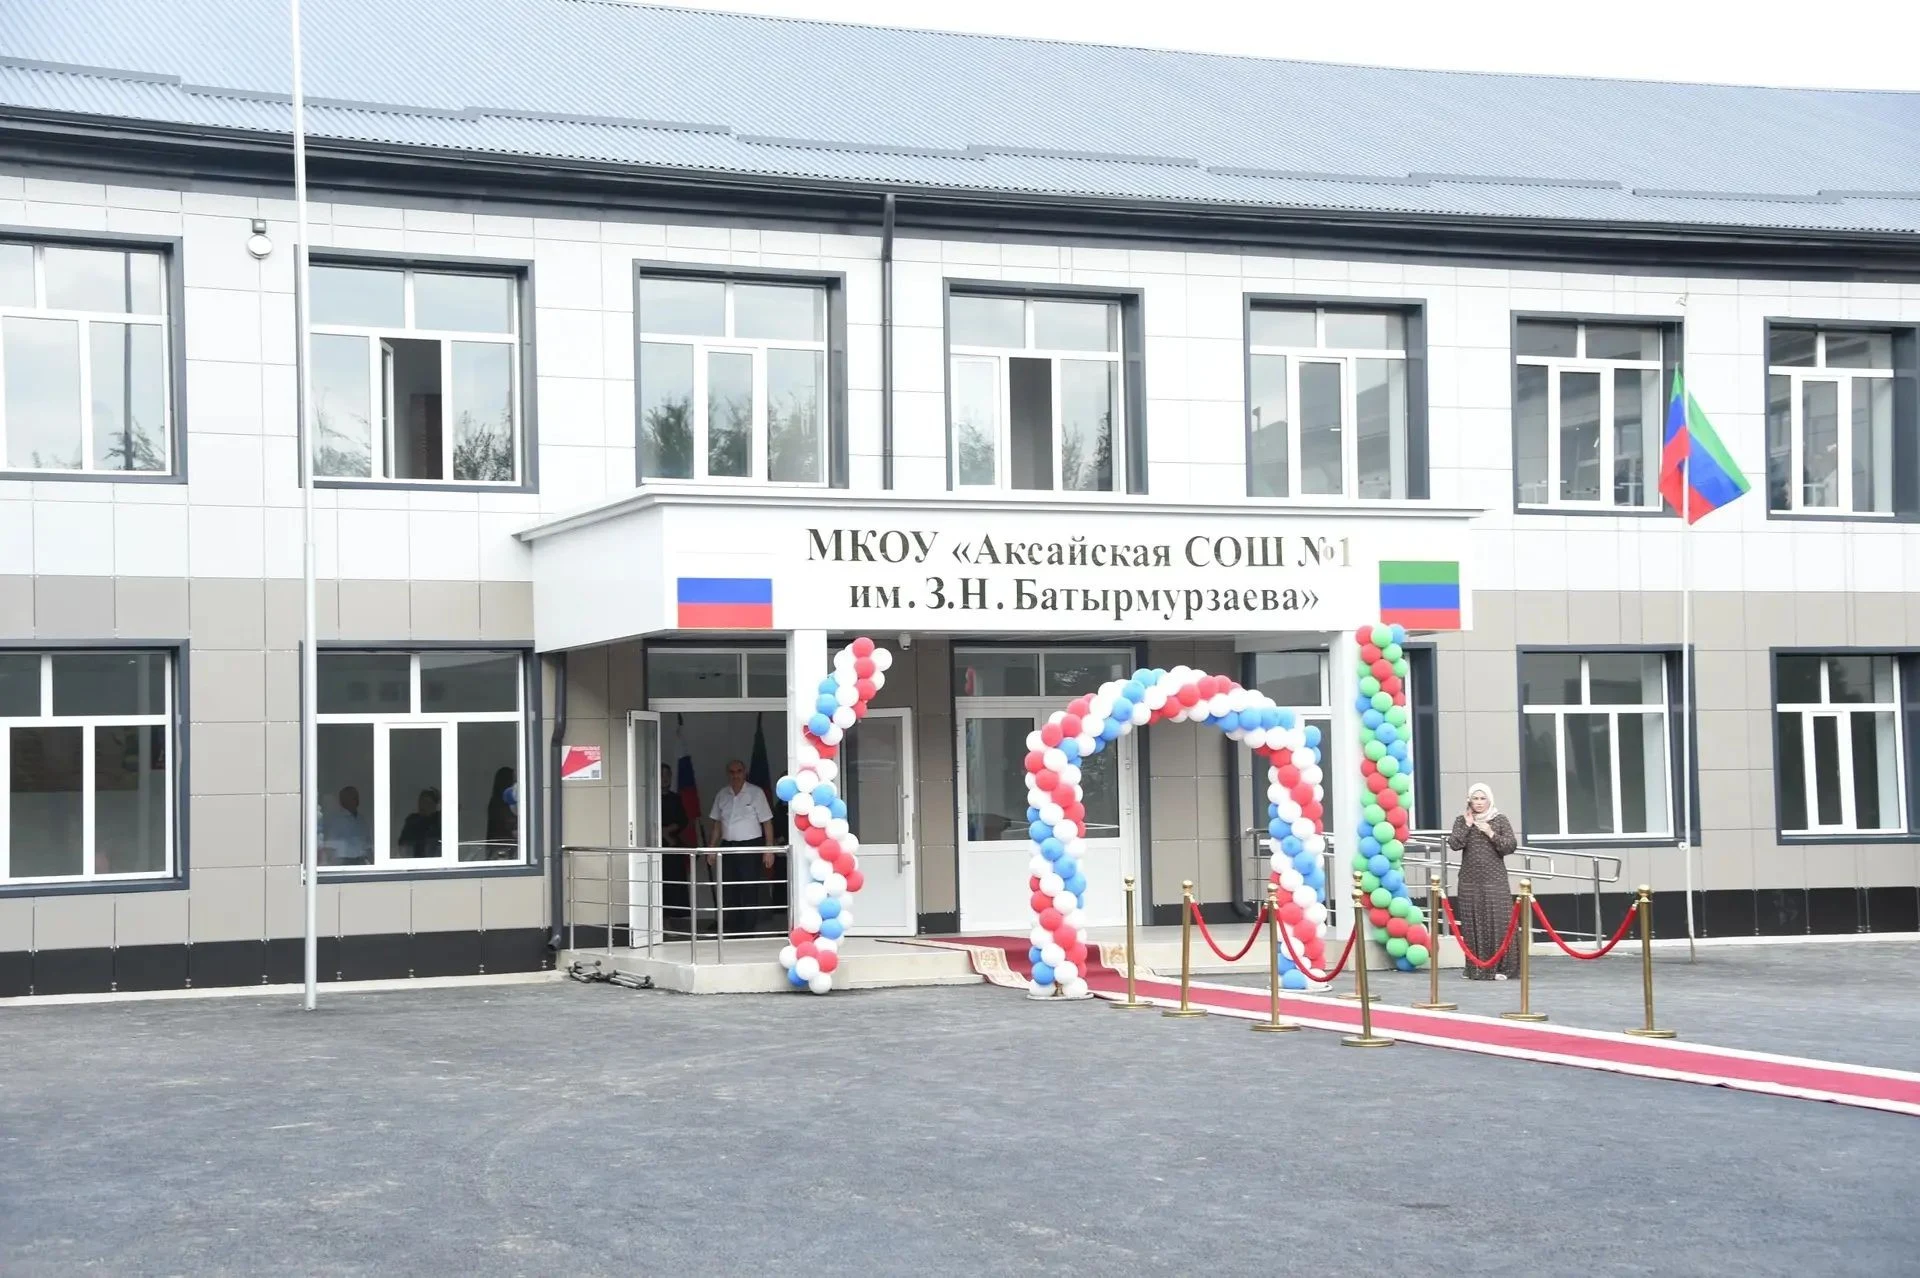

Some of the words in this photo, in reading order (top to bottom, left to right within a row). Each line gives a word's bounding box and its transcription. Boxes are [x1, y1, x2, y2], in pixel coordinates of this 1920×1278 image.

[805, 528, 939, 563] МКОУ
[952, 533, 1171, 568] «Аксайская
[1184, 535, 1285, 568] СОШ
[1297, 535, 1352, 568] №1
[849, 585, 916, 609] им.
[1012, 578, 1320, 621] Батырмурзаева»
